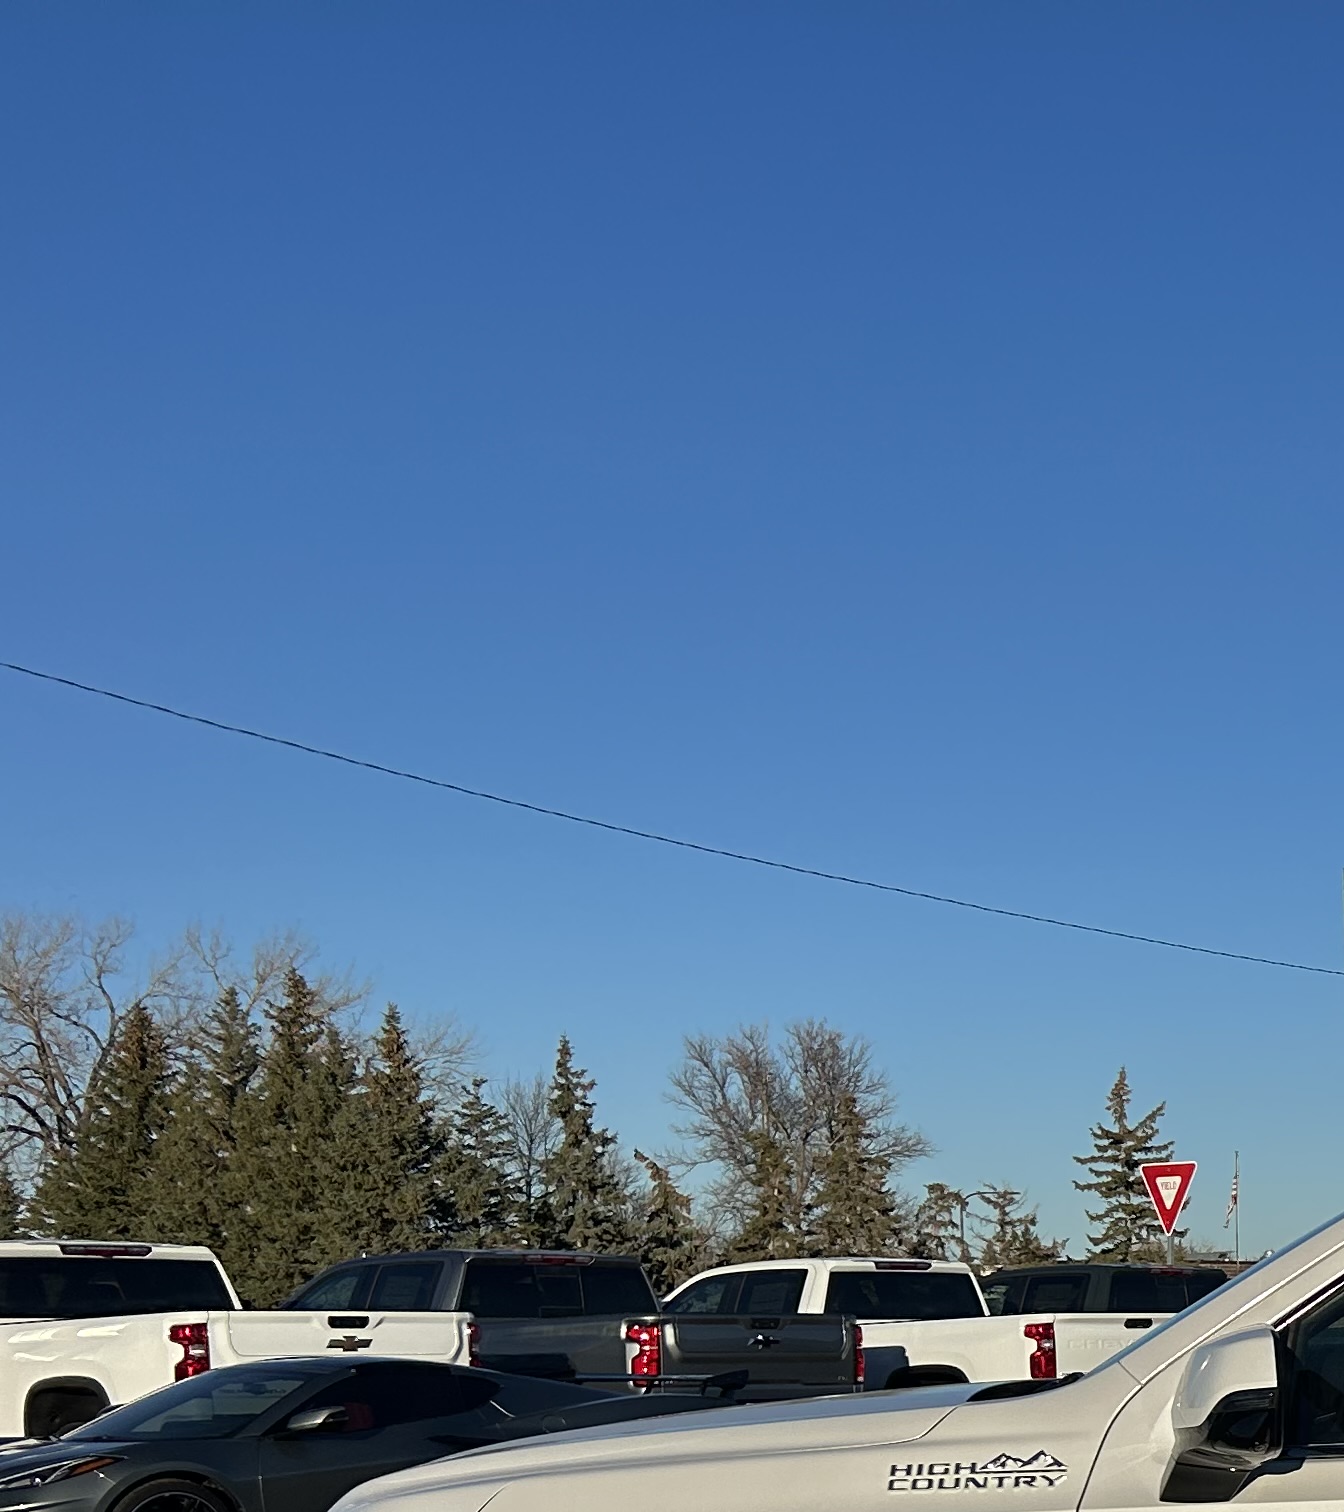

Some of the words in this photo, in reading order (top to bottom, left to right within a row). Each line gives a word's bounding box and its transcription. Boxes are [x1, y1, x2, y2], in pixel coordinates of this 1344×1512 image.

[1161, 1181, 1177, 1190] YIELD
[889, 1462, 977, 1477] HIGH
[887, 1475, 1067, 1491] COUNTRY
